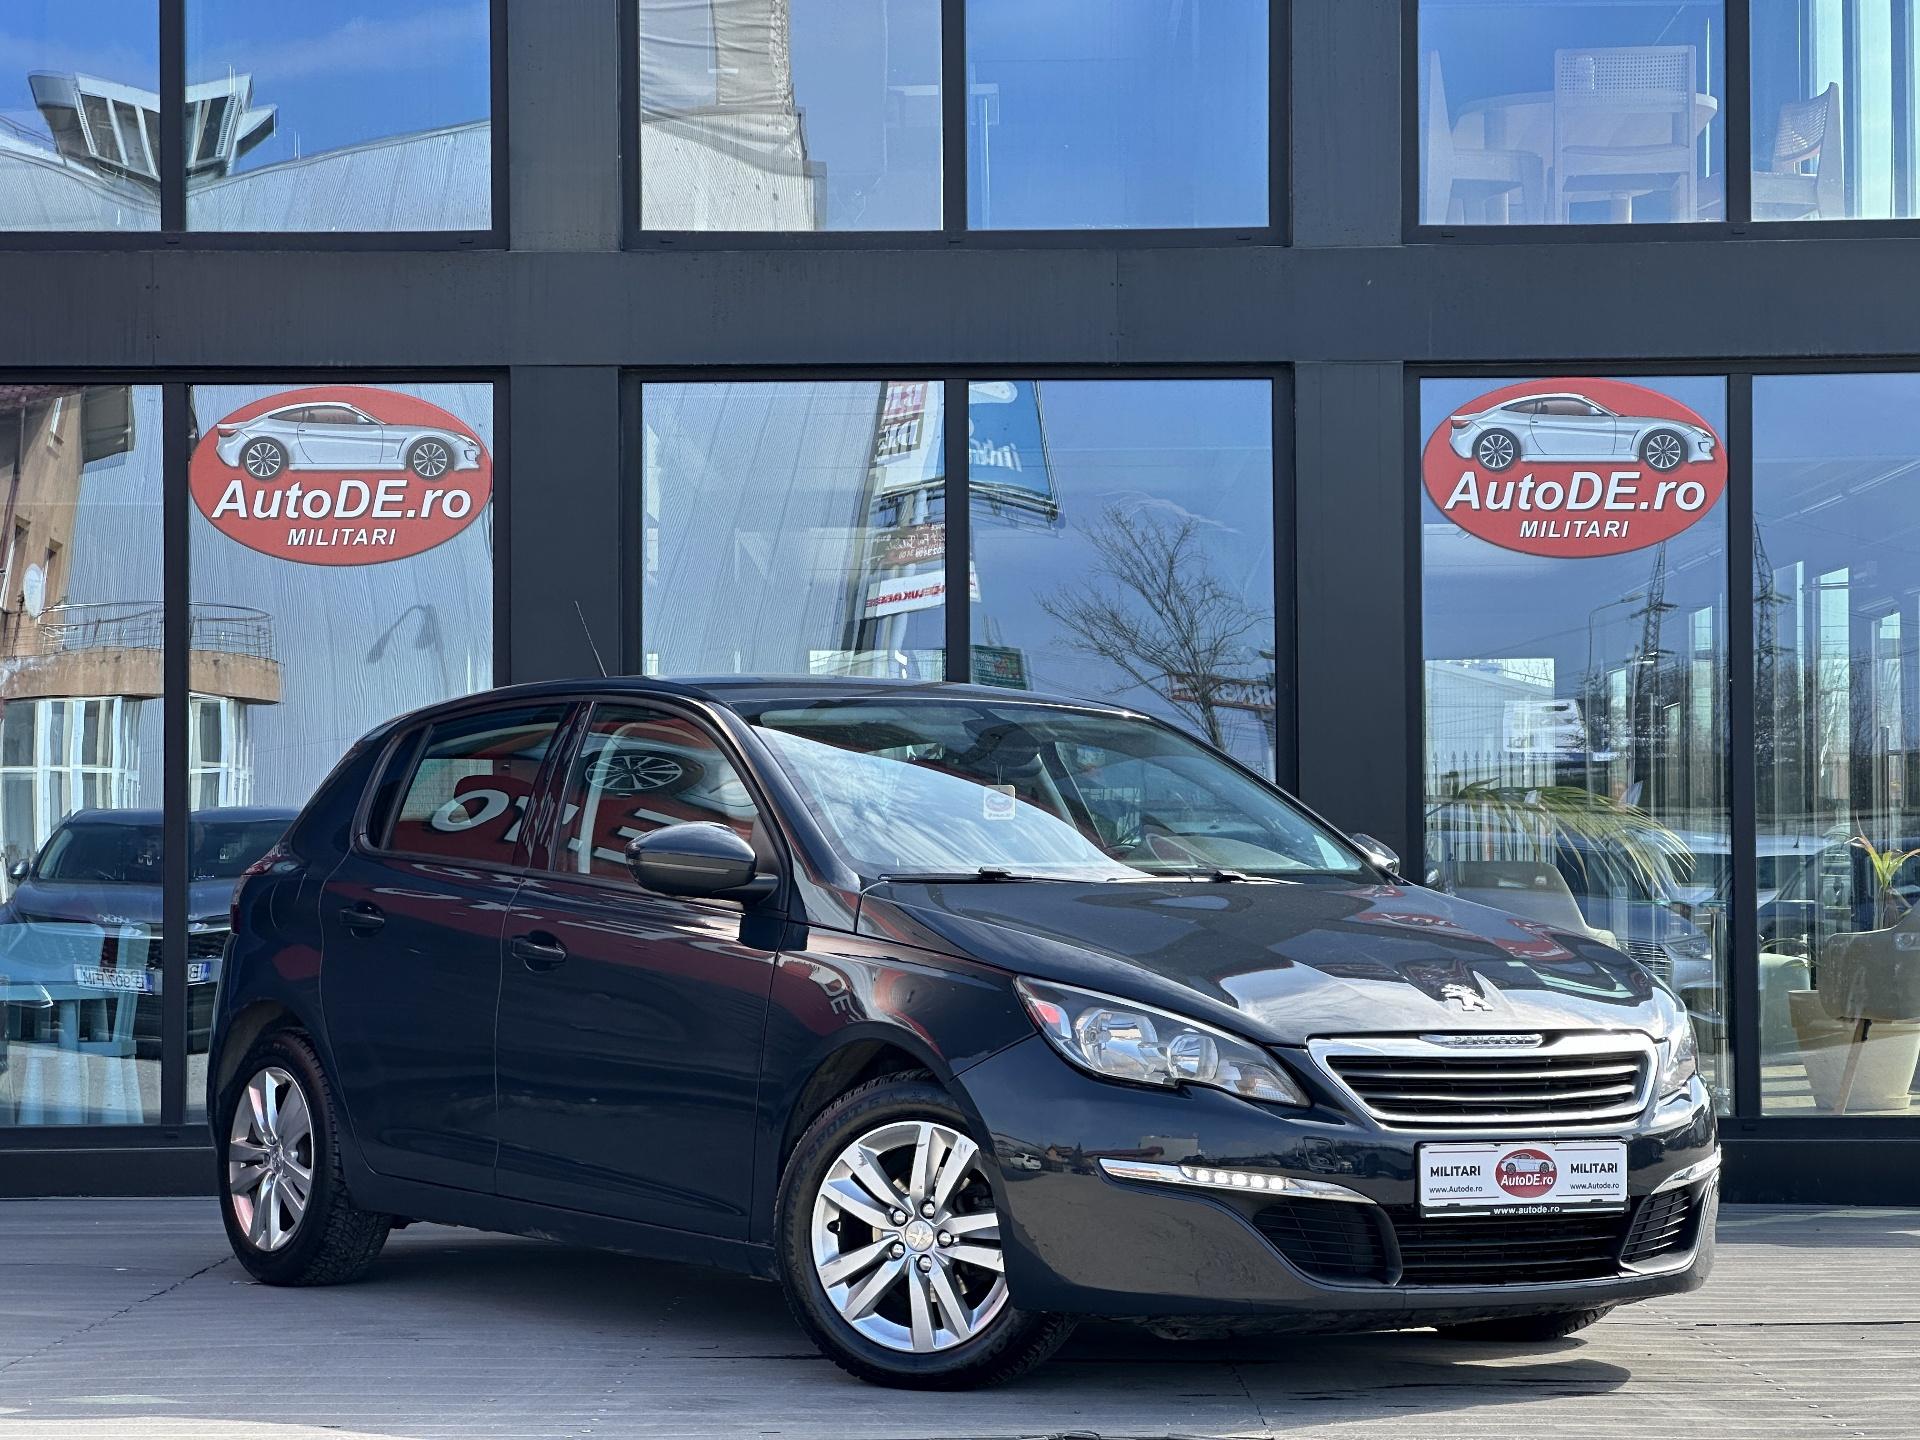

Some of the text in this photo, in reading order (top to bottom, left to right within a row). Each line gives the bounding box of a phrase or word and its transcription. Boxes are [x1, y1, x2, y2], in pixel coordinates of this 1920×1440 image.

[1444, 471, 1706, 511] AutoDE.ro
[211, 479, 472, 519] AutoDE.ro
[1519, 520, 1630, 538] MILITARI
[287, 528, 397, 546] MILITARI
[1454, 1036, 1528, 1045] PEUGEOT
[1430, 1165, 1481, 1178] MILITARI
[1570, 1162, 1618, 1174] MILITARI
[1500, 1173, 1554, 1187] AutoDE.ro
[1569, 1181, 1620, 1190] www.Autode.ro
[1429, 1184, 1483, 1193] www.Autode.ro
[1493, 1205, 1560, 1215] www.autode.ro
